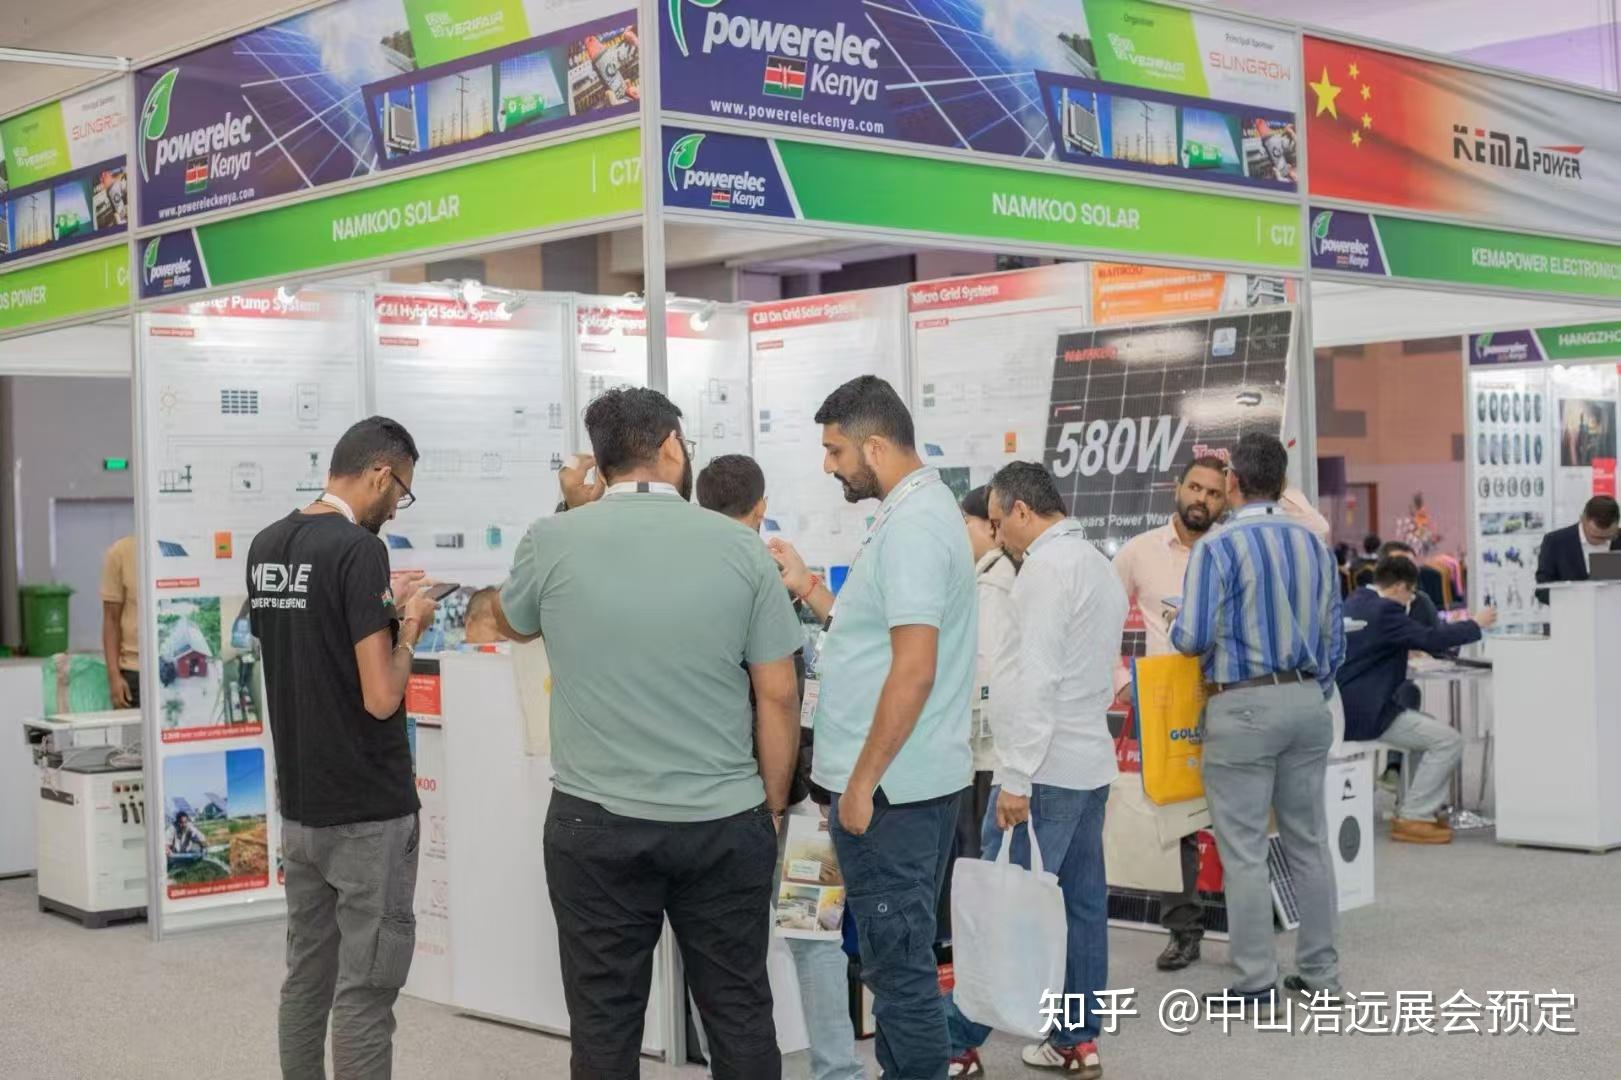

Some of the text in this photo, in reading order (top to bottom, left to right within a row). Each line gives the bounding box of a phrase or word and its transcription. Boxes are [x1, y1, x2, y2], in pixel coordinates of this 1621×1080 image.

[702, 11, 881, 69] powerelec
[1208, 51, 1291, 81] SUNGROW
[810, 64, 879, 104] Kenya
[710, 99, 885, 134] www.powereleckenya.com
[155, 112, 252, 174] powerelec
[210, 151, 251, 181] Kenya
[684, 170, 766, 192] powerelec
[158, 186, 255, 219] www.powereleckenya.com
[332, 157, 641, 242] NAMKOO SOLAR C17
[732, 190, 765, 208] Kenya
[992, 192, 1296, 246] NAMKOO SOLAR C17
[1320, 237, 1369, 256] powerelec
[150, 257, 191, 283] powerelec
[1349, 254, 1369, 268] Kenya
[1471, 247, 1549, 274] KEMAPOWER
[11, 285, 47, 311] POWER
[231, 296, 270, 313] Pump
[912, 284, 999, 304] Micro Grid System
[400, 303, 438, 321] Hybrid
[768, 310, 782, 322] On
[783, 306, 801, 320] Grid
[801, 304, 822, 319] Solar
[1053, 414, 1189, 478] 580W
[1109, 514, 1141, 527] Power
